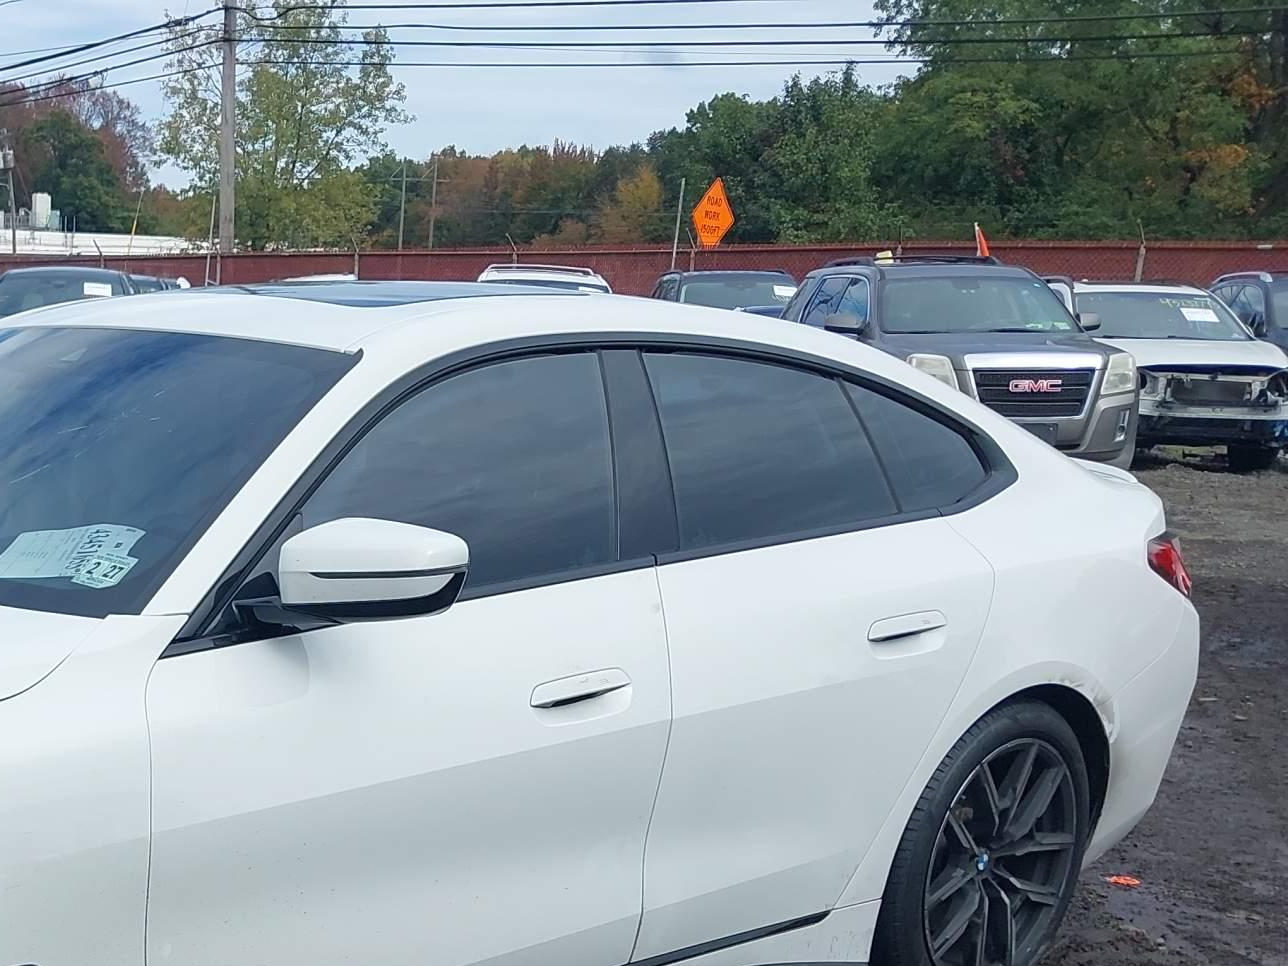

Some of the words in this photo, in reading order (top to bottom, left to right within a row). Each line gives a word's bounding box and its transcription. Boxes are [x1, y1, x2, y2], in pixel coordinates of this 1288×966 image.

[706, 196, 723, 208] ROAD
[704, 210, 721, 221] WORK
[1009, 379, 1062, 392] GMC
[85, 562, 102, 575] 2
[101, 564, 125, 579] 27
